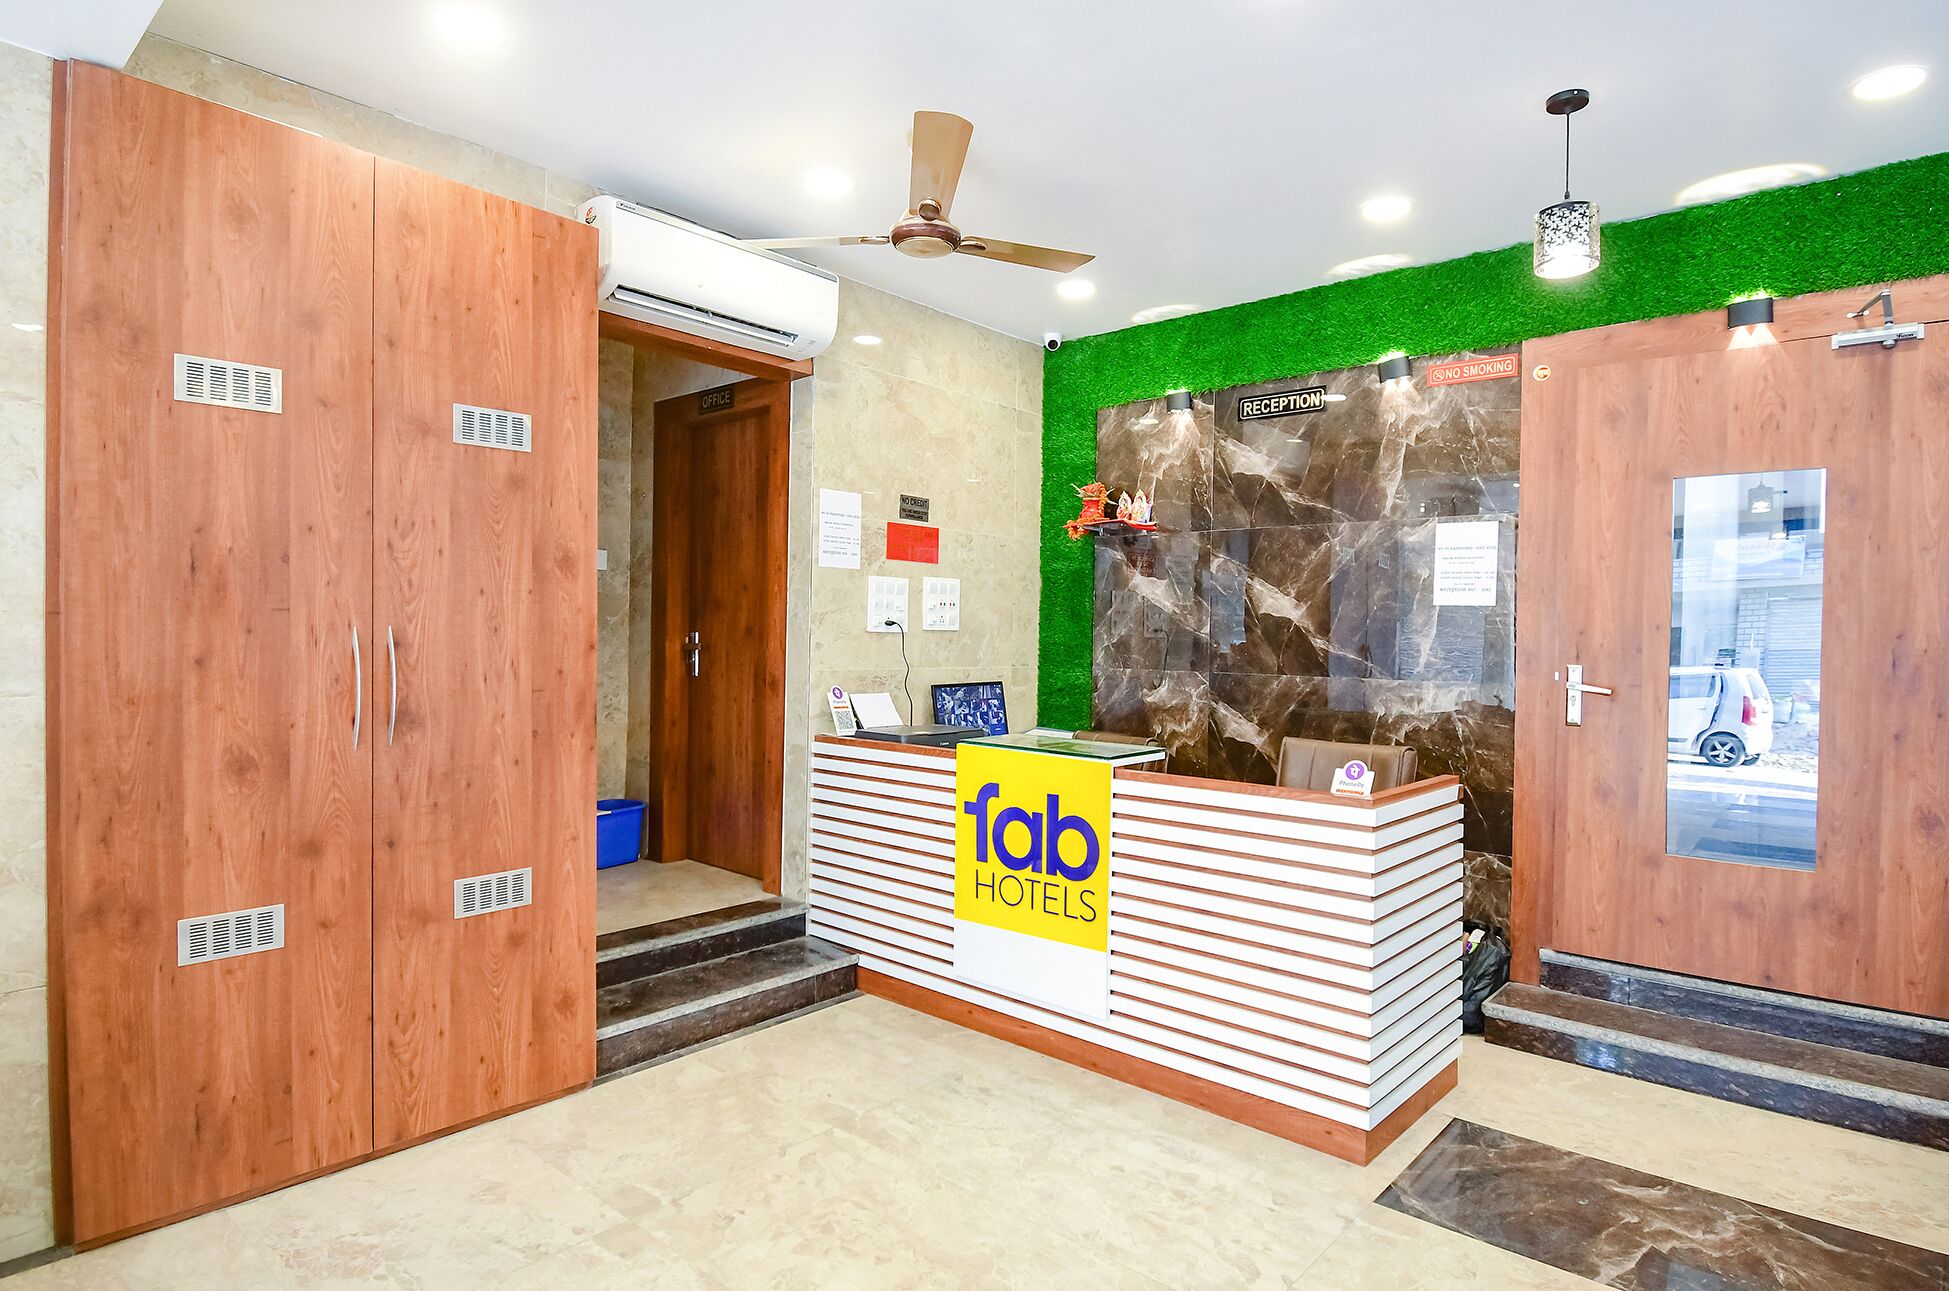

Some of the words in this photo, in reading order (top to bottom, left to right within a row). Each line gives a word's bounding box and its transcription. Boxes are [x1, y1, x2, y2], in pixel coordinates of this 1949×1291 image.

[1445, 367, 1460, 379] NO
[1463, 360, 1513, 377] SMOKING
[702, 390, 731, 408] OFFICE
[1243, 391, 1321, 416] RECEPTION
[901, 497, 909, 505] NO
[910, 498, 928, 508] CREDIT
[1339, 780, 1365, 788] PhonePe
[964, 782, 1100, 882] fab
[976, 869, 1097, 922] HOTELS
